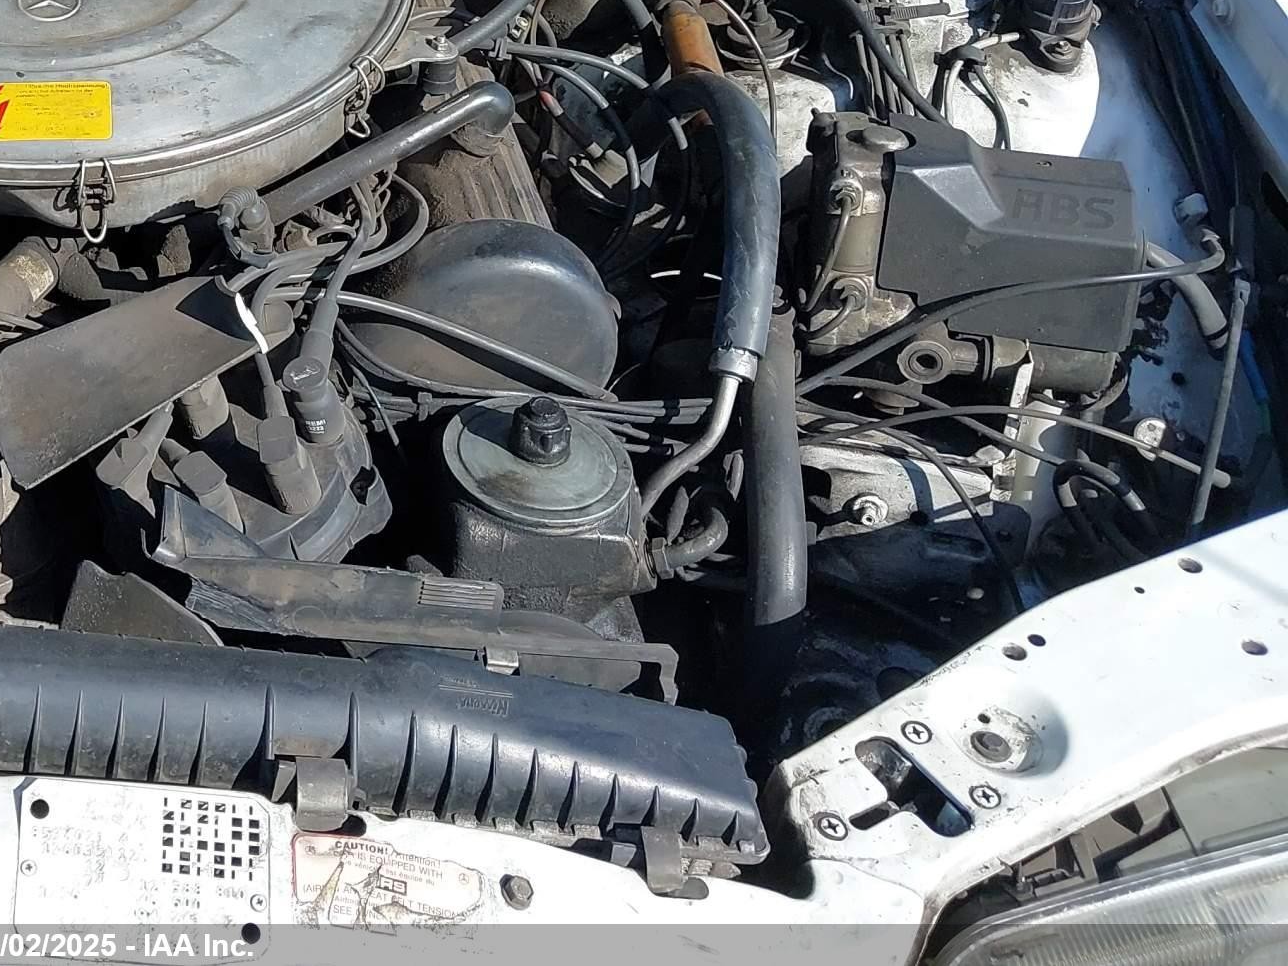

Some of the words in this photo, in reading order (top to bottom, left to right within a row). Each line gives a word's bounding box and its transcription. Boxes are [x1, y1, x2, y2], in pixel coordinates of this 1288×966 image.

[1011, 188, 1115, 229] ABS
[334, 840, 389, 855] CAUTION!
[369, 853, 417, 873] EQUIPPED
[418, 865, 444, 881] WITH
